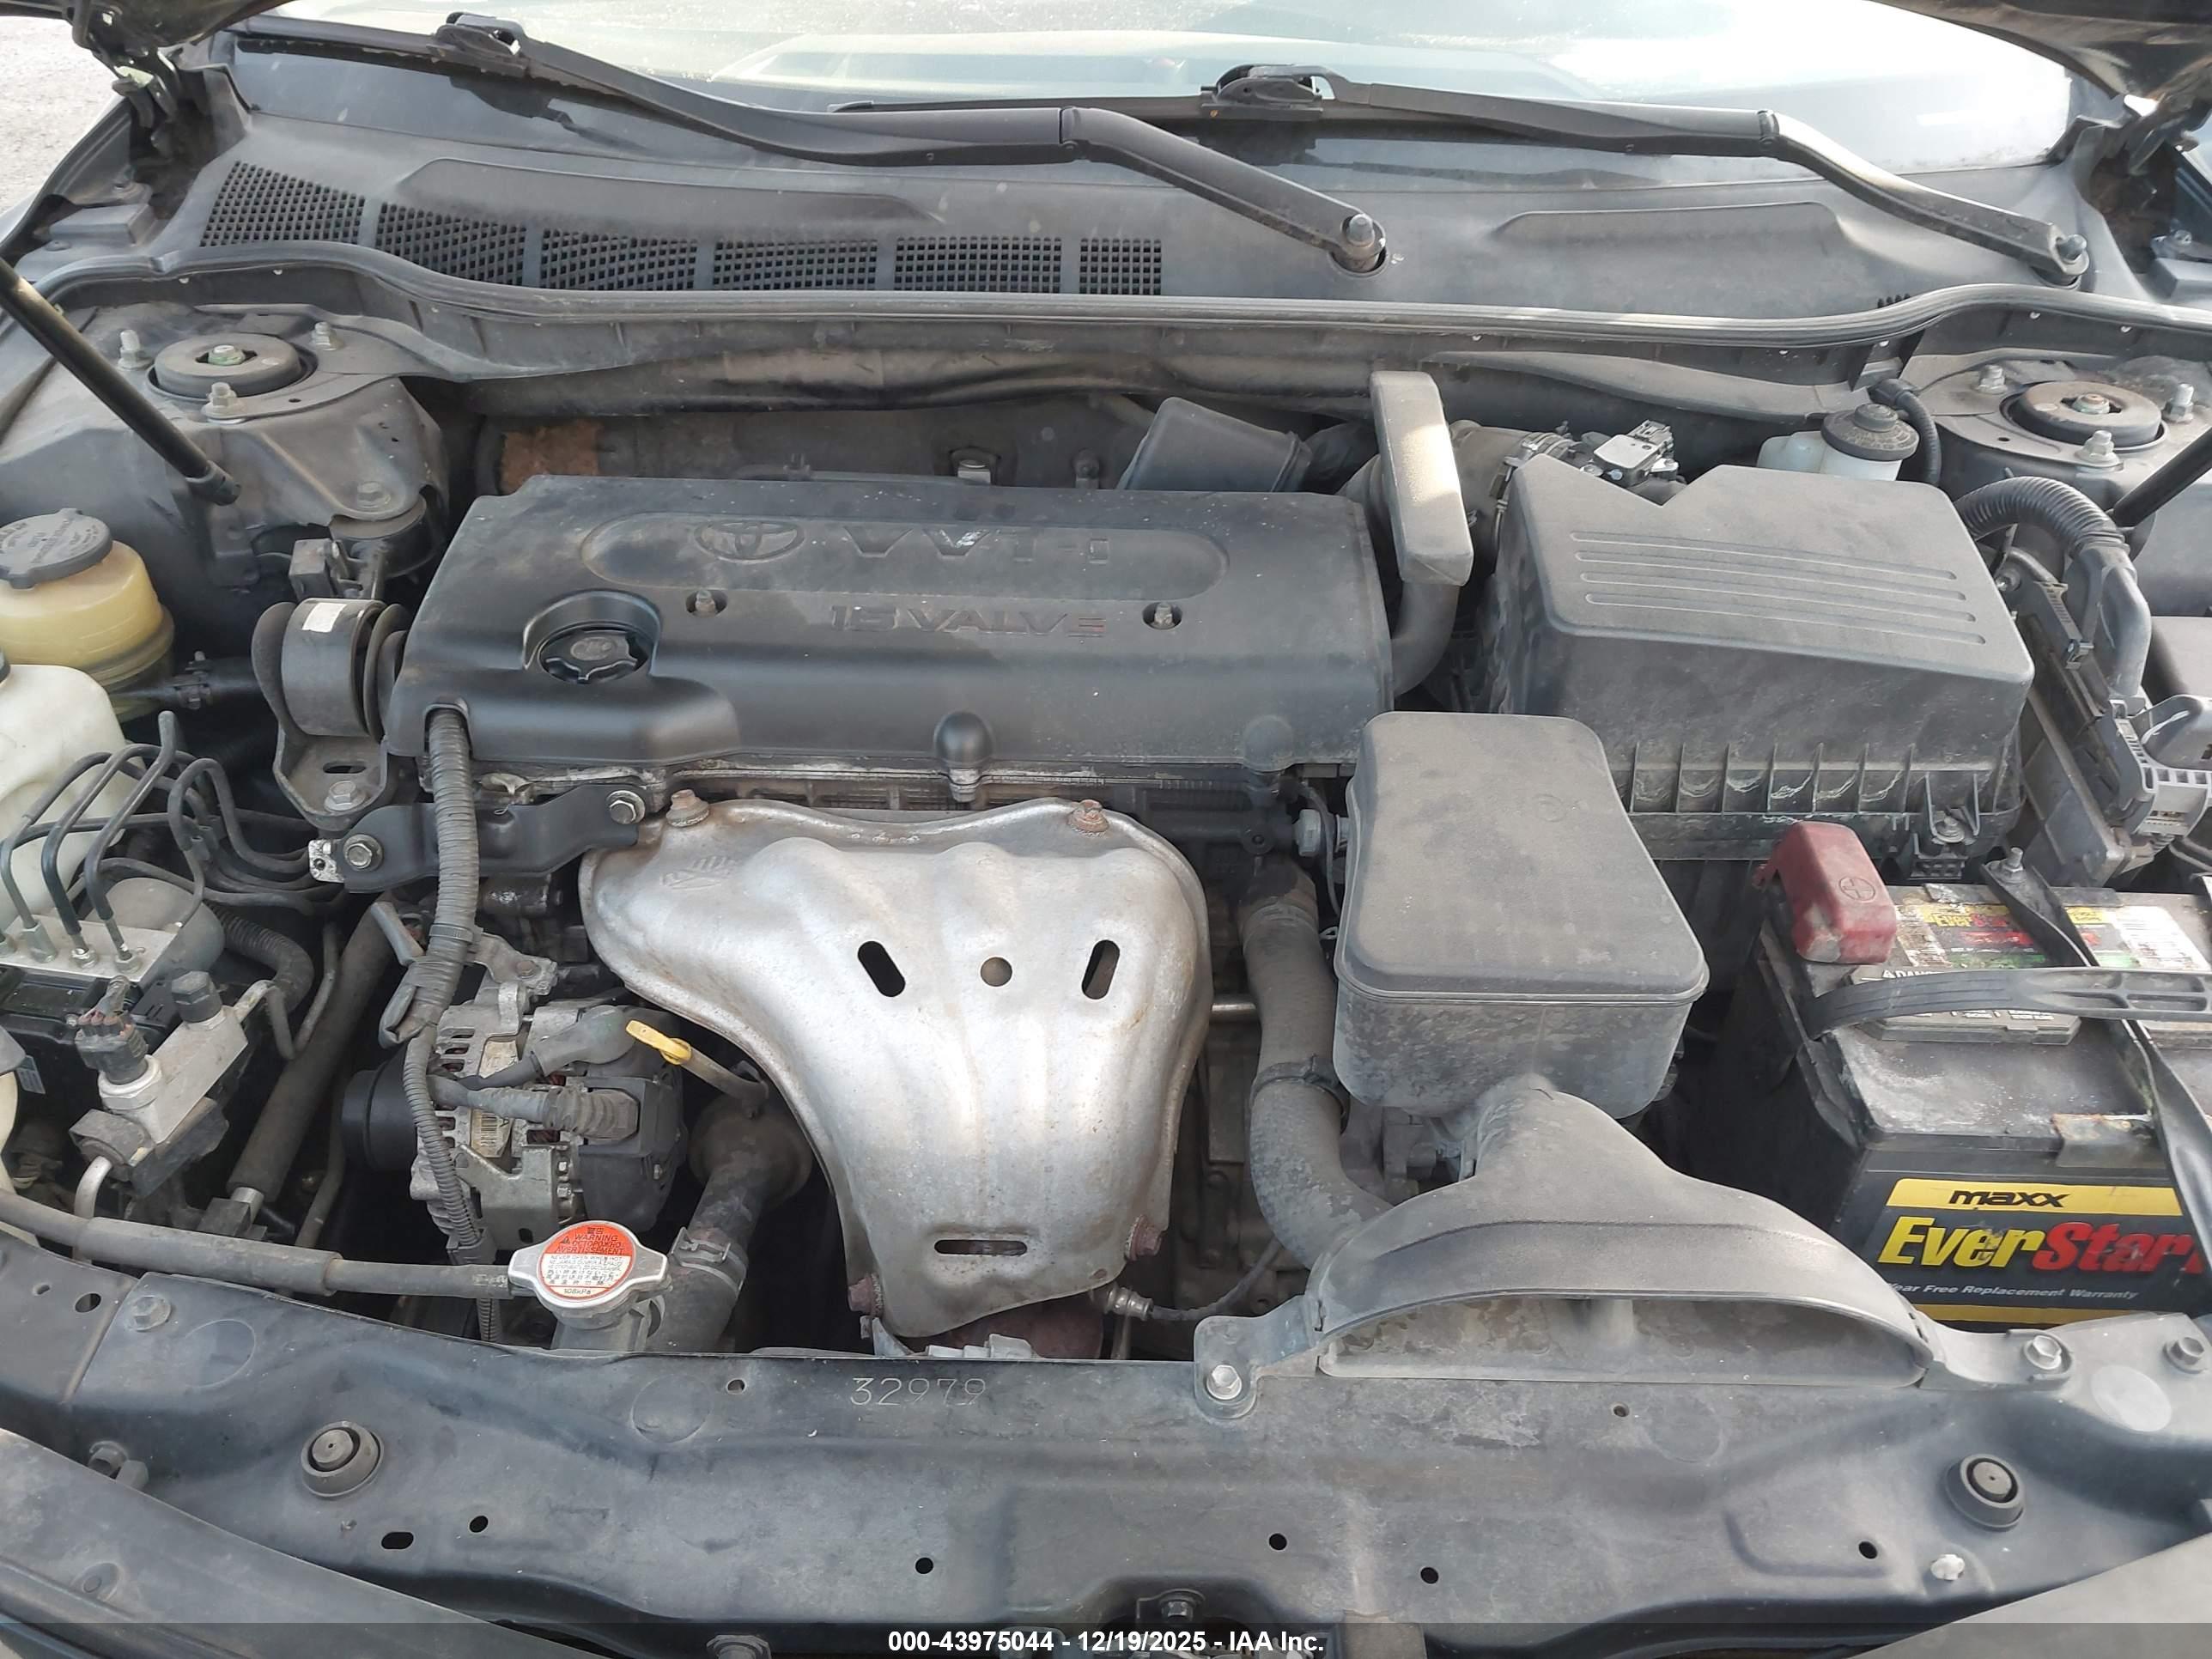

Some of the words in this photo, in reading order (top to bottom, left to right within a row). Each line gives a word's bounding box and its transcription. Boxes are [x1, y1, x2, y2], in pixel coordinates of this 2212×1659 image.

[1948, 1190, 2072, 1207] maxx
[556, 1245, 625, 1255] AVERTISSEMENT
[1923, 1285, 1959, 1293] Free
[1961, 1285, 2065, 1297] Replacement
[2069, 1289, 2139, 1299] Warranty
[850, 1377, 987, 1407] 32979
